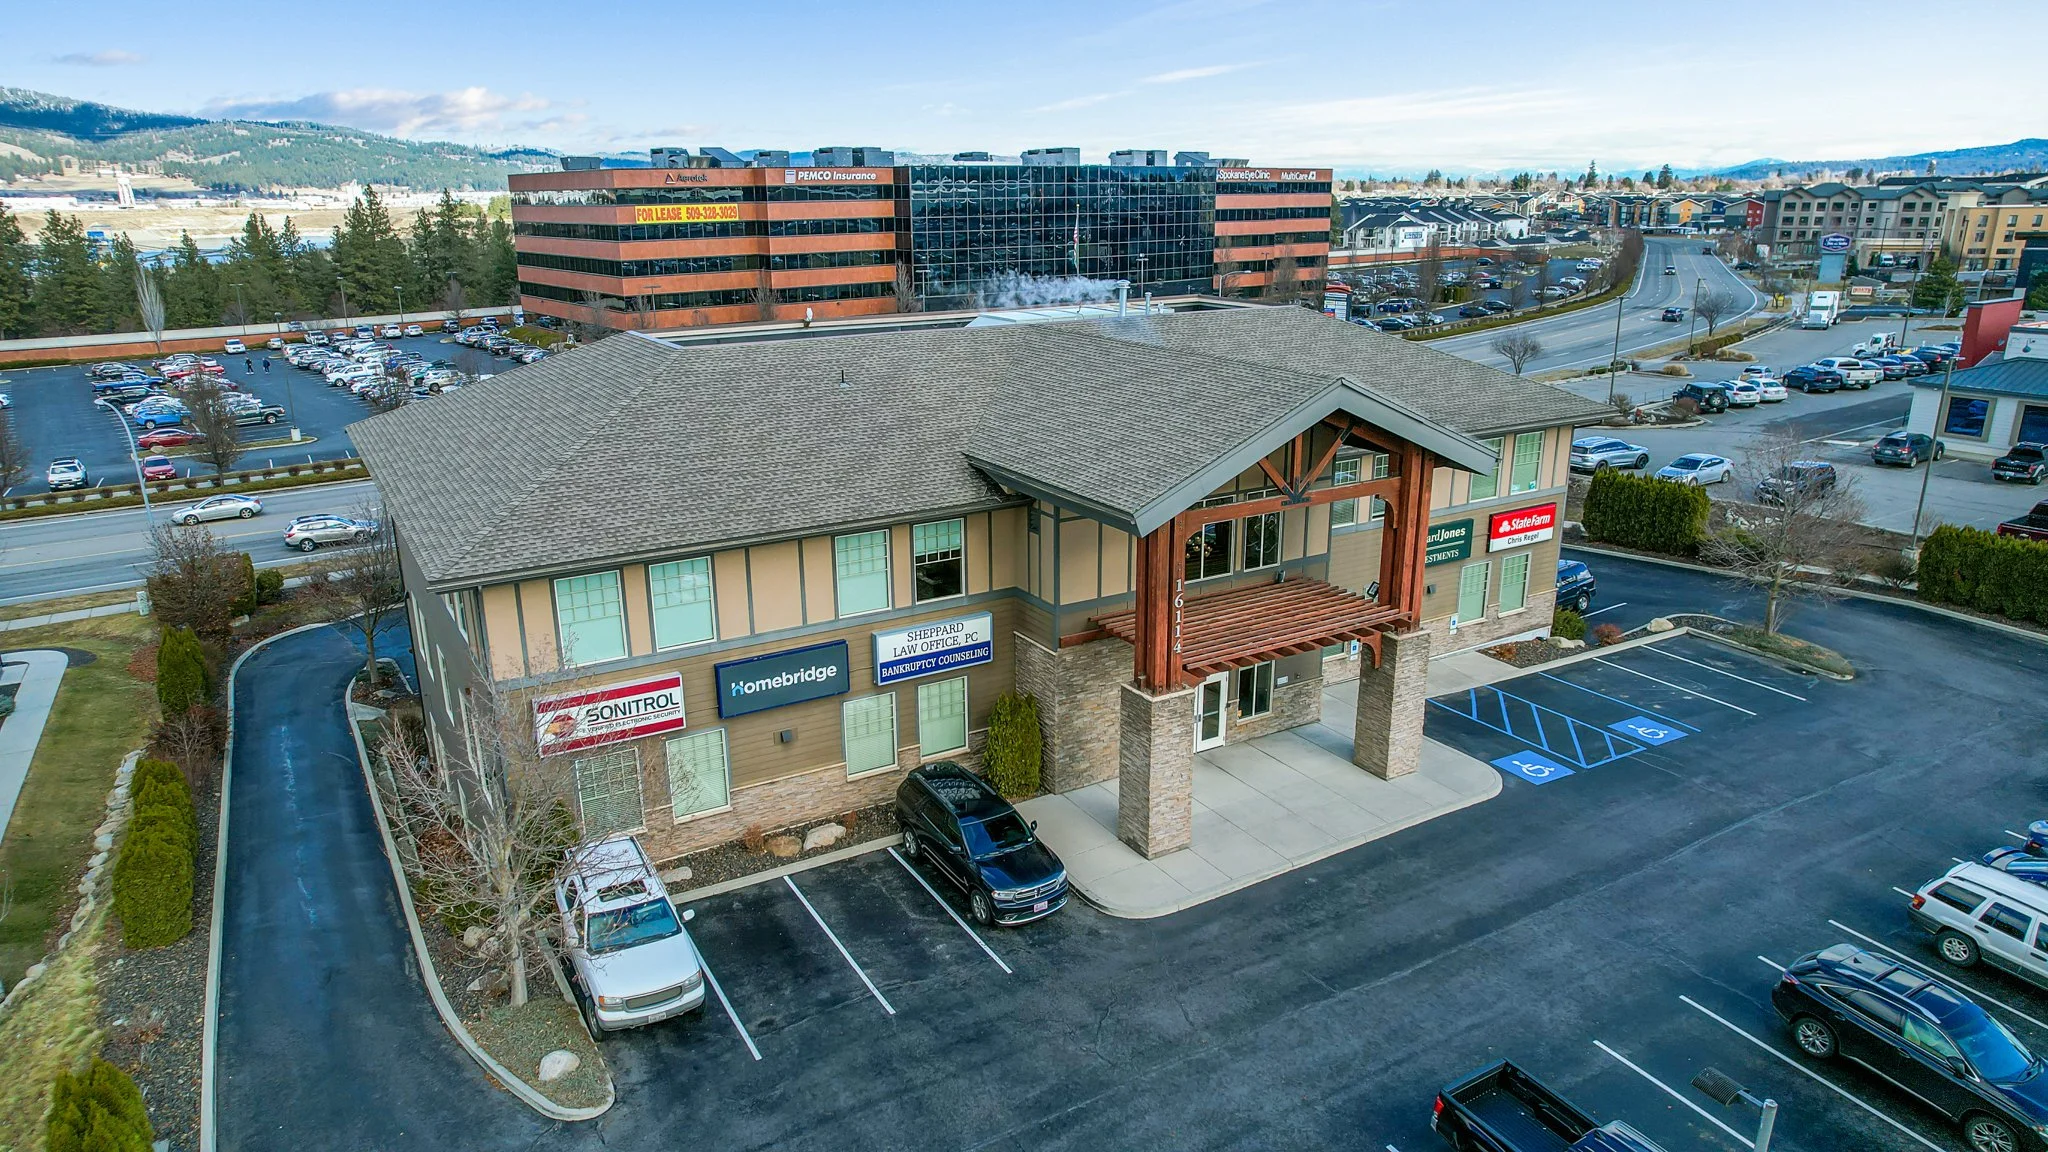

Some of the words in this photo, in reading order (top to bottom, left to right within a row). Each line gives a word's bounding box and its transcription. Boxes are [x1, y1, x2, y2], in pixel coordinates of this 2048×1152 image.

[798, 171, 831, 182] PEMCO
[832, 171, 877, 181] Insurance
[1281, 171, 1308, 180] MultiCare
[636, 207, 654, 221] FOR
[655, 206, 682, 221] LEASE
[686, 204, 738, 220] 509-328-3029
[1507, 534, 1523, 545] Chris
[1523, 532, 1539, 542] Regel
[1425, 549, 1459, 564] ESTMENTS
[1173, 578, 1184, 654] 16114
[907, 622, 964, 642] SHEPPARD
[893, 643, 918, 658] LAW
[920, 635, 961, 652] OFFICE,
[964, 631, 979, 644] PC
[881, 657, 937, 678] BANKRUPTCY
[938, 647, 989, 665] COUNSELING
[731, 665, 838, 697] Homebridge
[586, 692, 680, 723] SONITROL
[615, 715, 653, 728] ELECTRONIC
[653, 709, 681, 720] SECURITY
